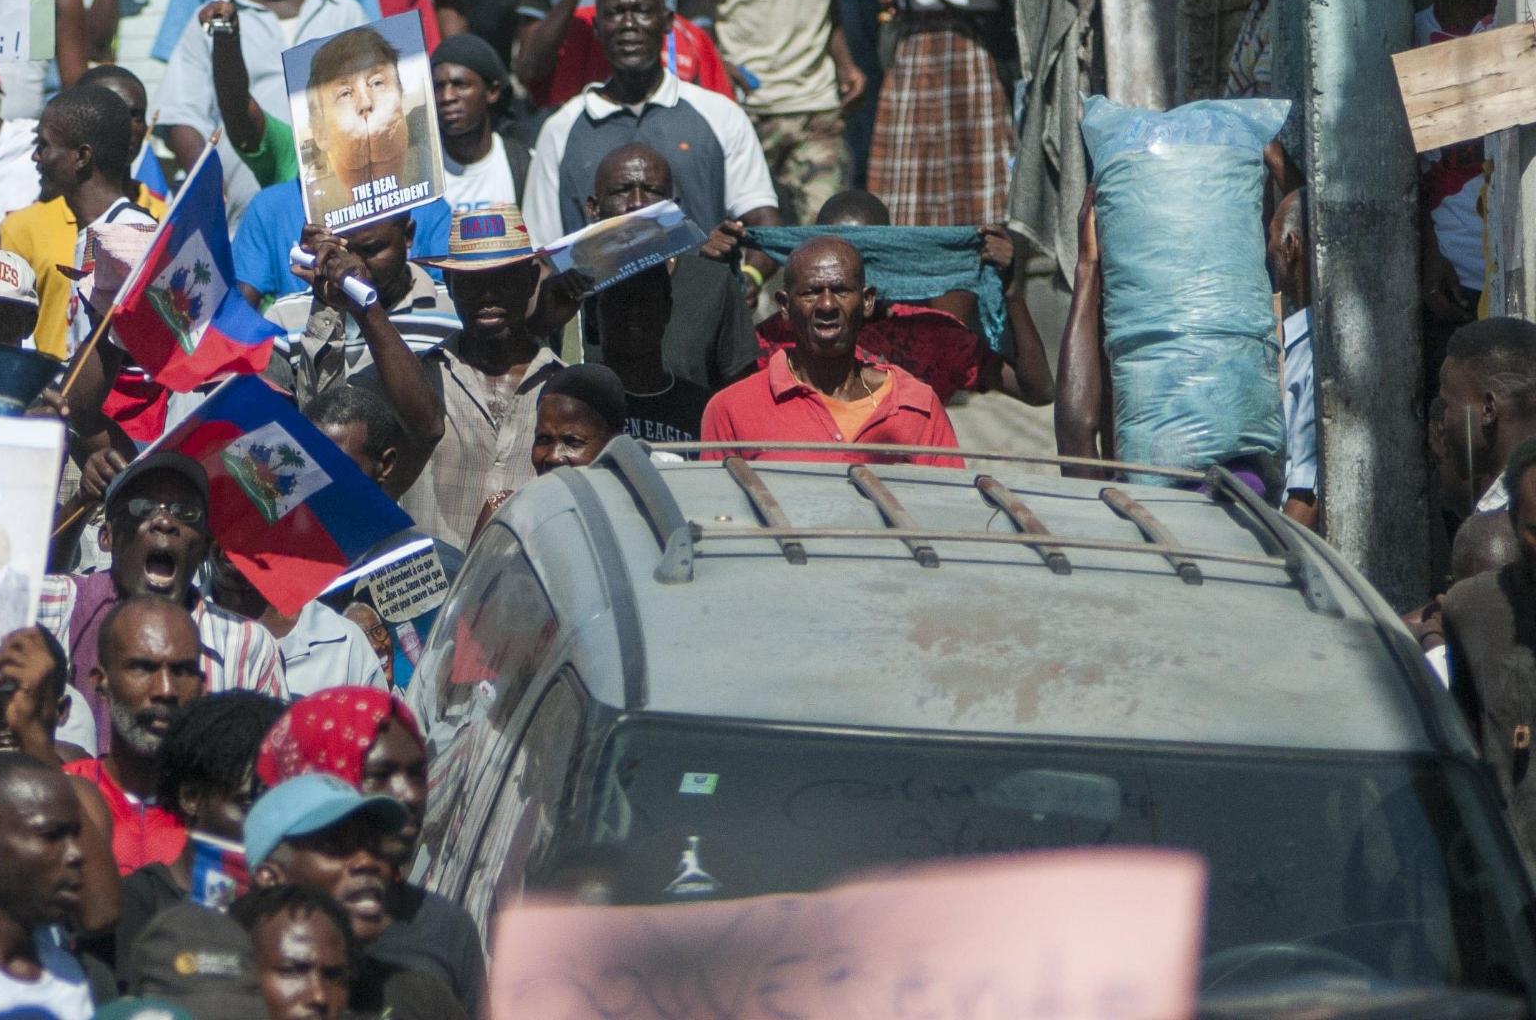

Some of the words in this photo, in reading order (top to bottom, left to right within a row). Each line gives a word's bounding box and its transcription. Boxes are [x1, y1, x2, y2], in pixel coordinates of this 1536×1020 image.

[324, 200, 375, 228] SHITHOLE
[374, 181, 430, 212] PRESIDENT
[352, 182, 373, 202] THE
[373, 175, 399, 195] REAL
